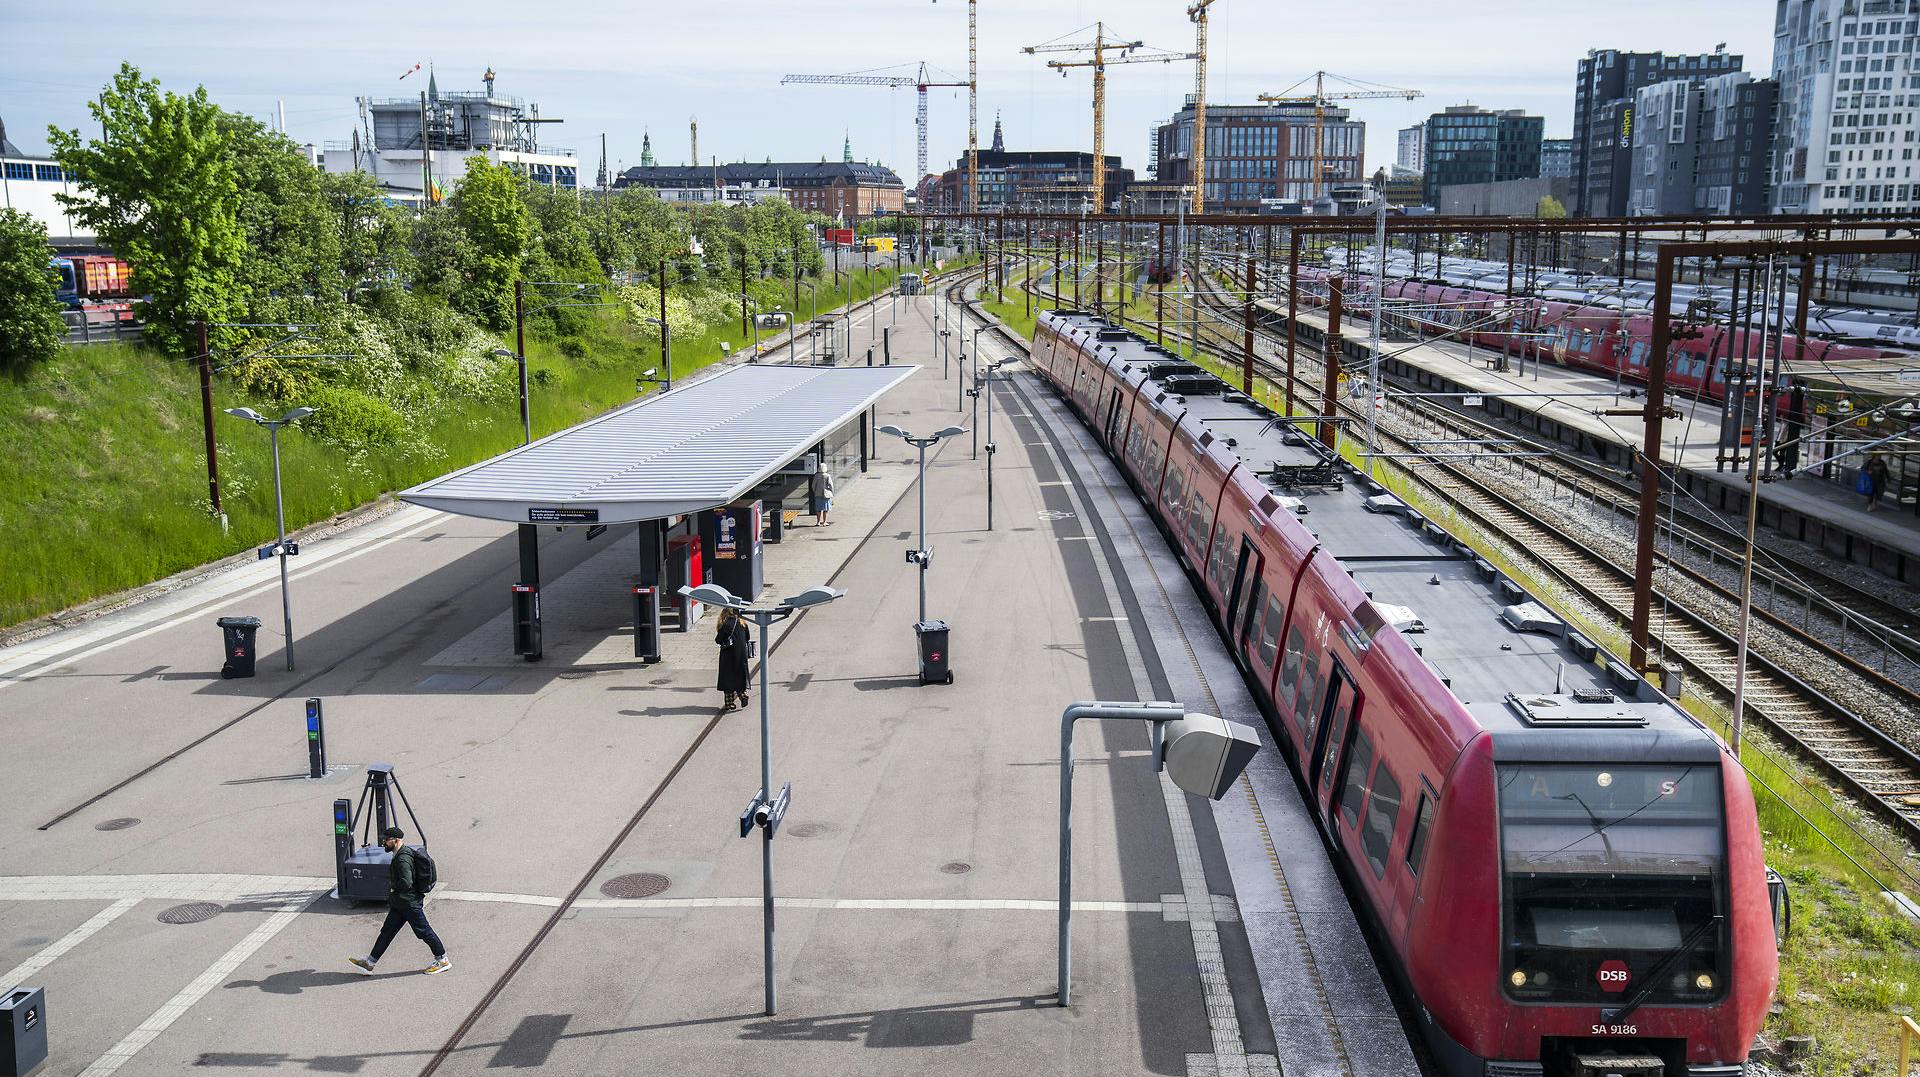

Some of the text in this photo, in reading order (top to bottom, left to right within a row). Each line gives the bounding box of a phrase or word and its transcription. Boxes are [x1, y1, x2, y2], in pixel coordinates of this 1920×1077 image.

[1530, 775, 1549, 797] A
[1600, 970, 1627, 981] DSB
[1591, 1024, 1637, 1035] SA 9186
